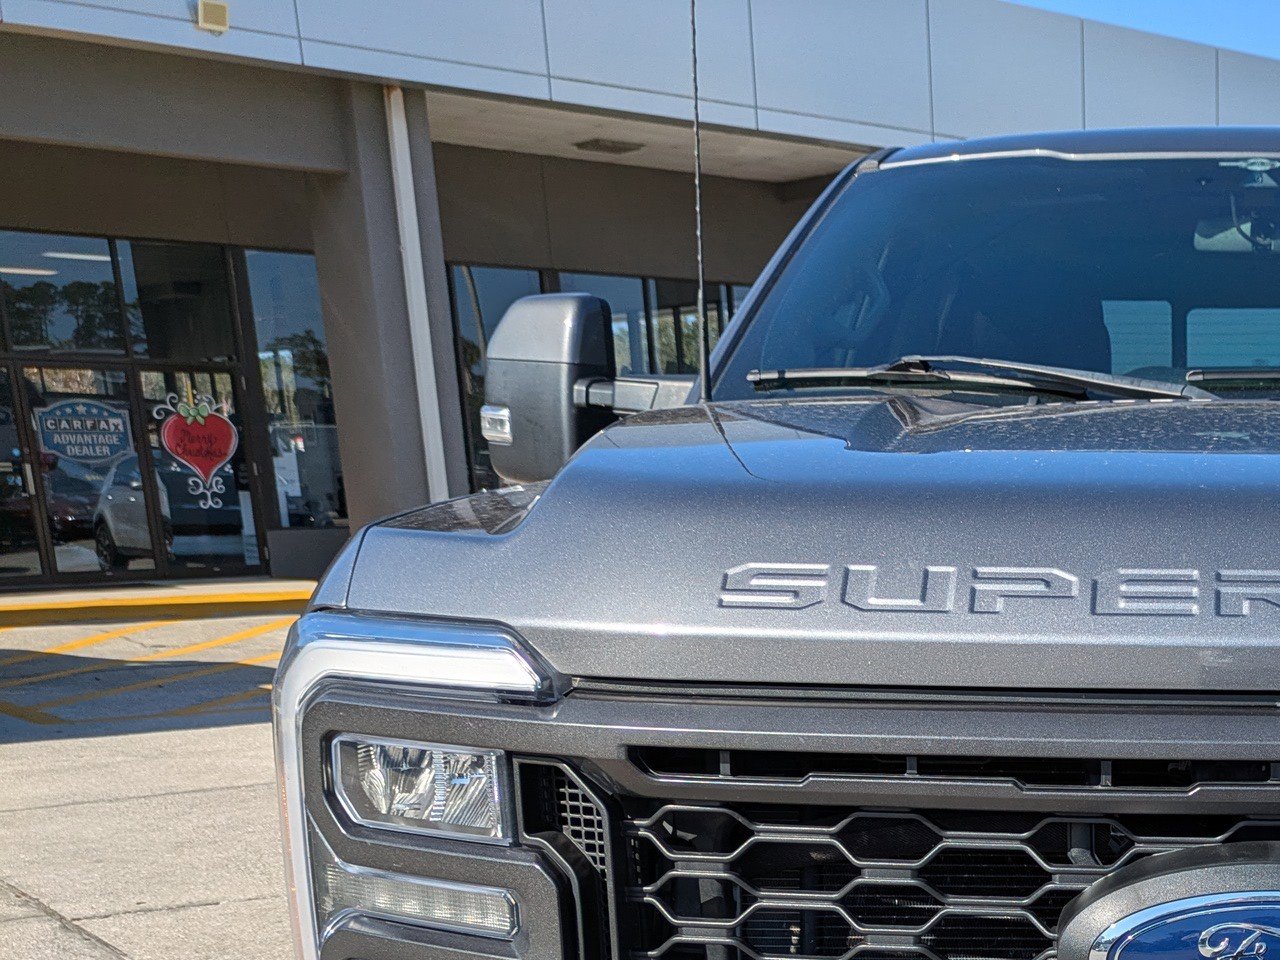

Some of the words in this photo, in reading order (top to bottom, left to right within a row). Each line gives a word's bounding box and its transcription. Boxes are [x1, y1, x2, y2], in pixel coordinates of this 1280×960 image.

[46, 418, 123, 431] CARFAX
[53, 433, 121, 445] ADVANTAGE
[66, 445, 111, 456] DEALER
